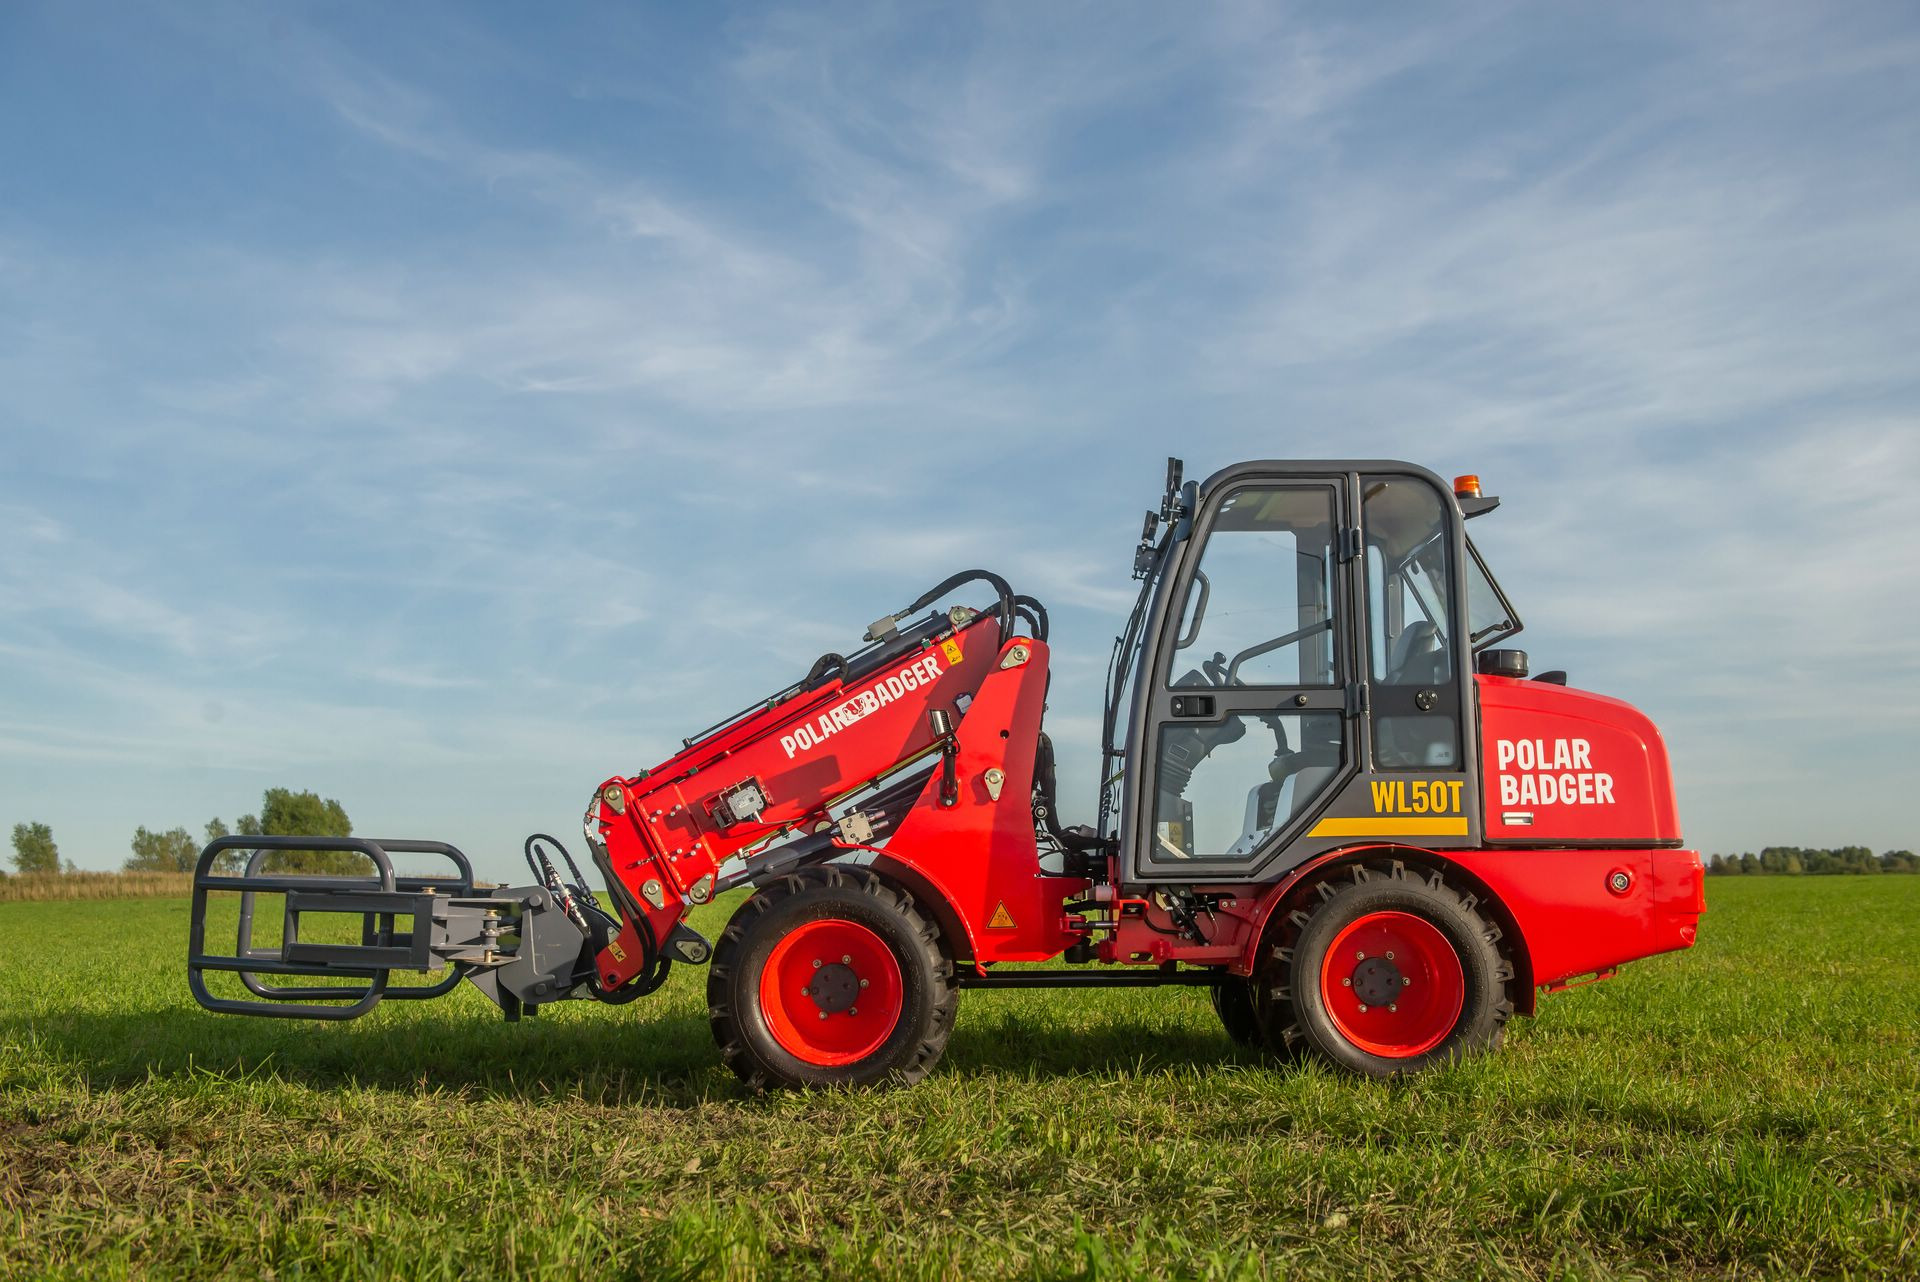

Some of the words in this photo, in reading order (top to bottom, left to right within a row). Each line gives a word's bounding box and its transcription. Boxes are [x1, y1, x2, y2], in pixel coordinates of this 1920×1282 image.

[780, 706, 848, 759] POLAR
[863, 657, 943, 712] BADGER
[1497, 738, 1592, 771] POLAR
[1370, 780, 1464, 813] WL50T
[1499, 773, 1616, 806] BADGER
